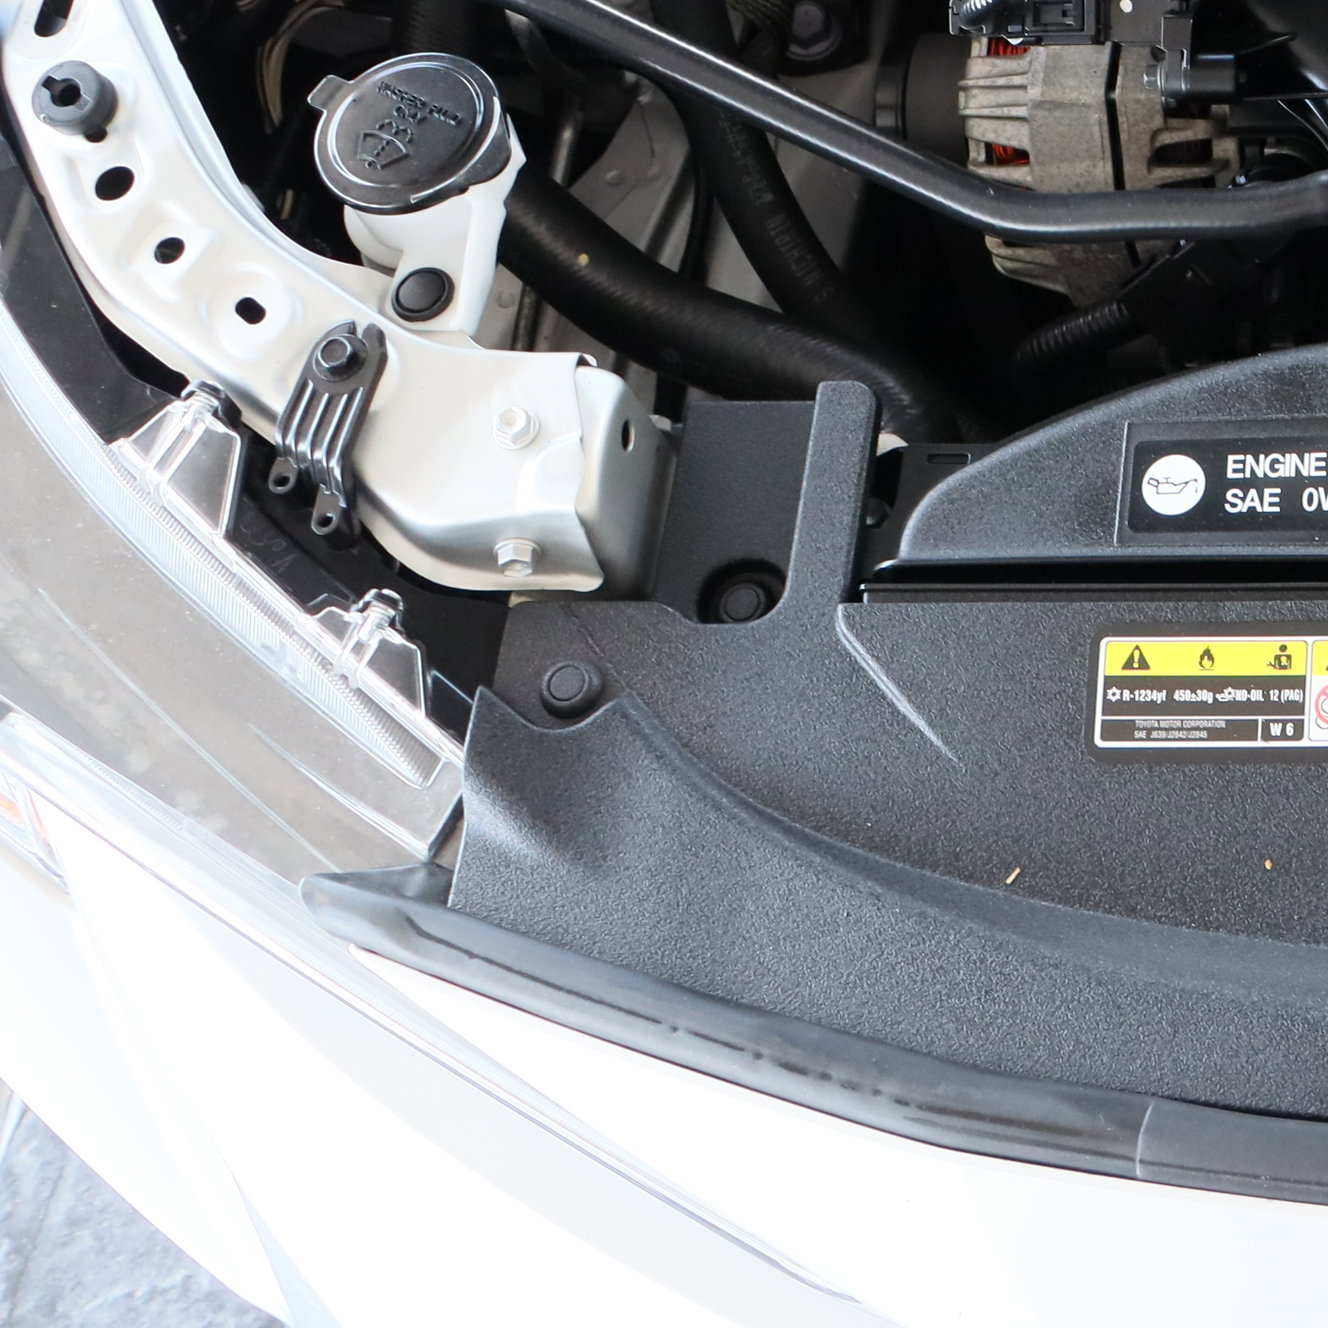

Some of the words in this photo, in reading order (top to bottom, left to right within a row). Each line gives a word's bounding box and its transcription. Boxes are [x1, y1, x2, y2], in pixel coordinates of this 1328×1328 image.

[1225, 452, 1327, 479] ENGINE
[1224, 487, 1281, 513] SAE
[1122, 689, 1167, 704] R-1234yf
[1173, 689, 1214, 704] 450±30g
[1269, 689, 1280, 701] 12
[1281, 689, 1304, 704] (PAG)
[1285, 723, 1295, 736] 6
